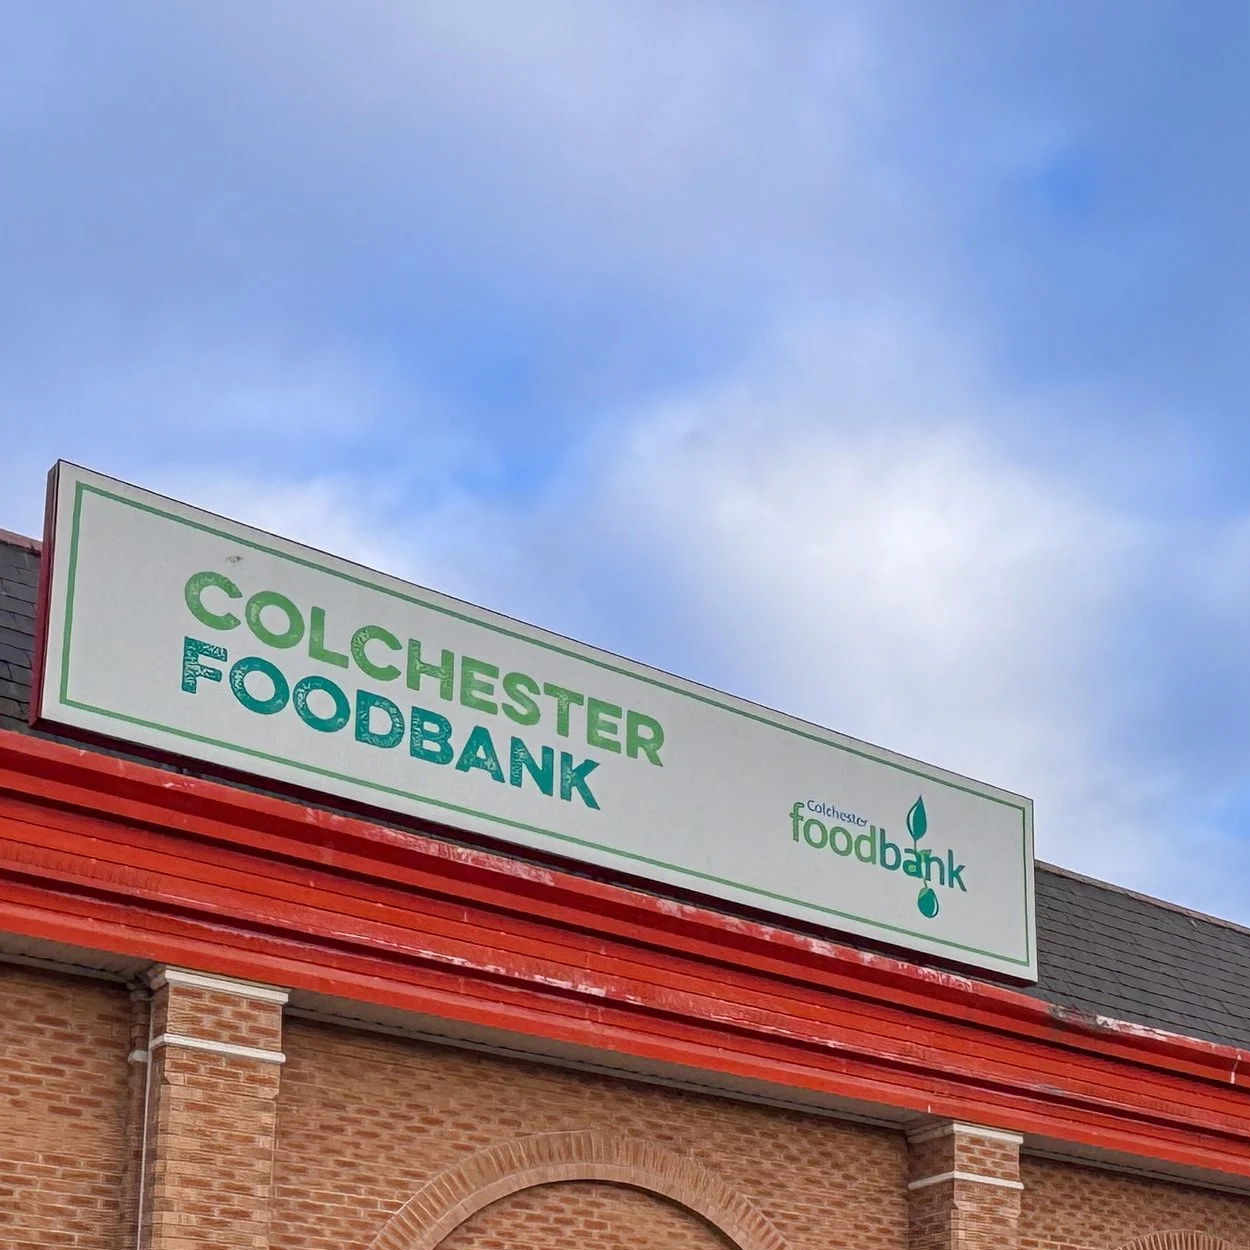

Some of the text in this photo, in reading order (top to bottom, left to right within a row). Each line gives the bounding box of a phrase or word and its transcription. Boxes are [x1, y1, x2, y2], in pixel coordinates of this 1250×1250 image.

[181, 635, 601, 811] FOODBANK
[184, 571, 665, 768] COLCHESTER
[789, 801, 968, 892] foodbank
[807, 799, 869, 828] Colchester
